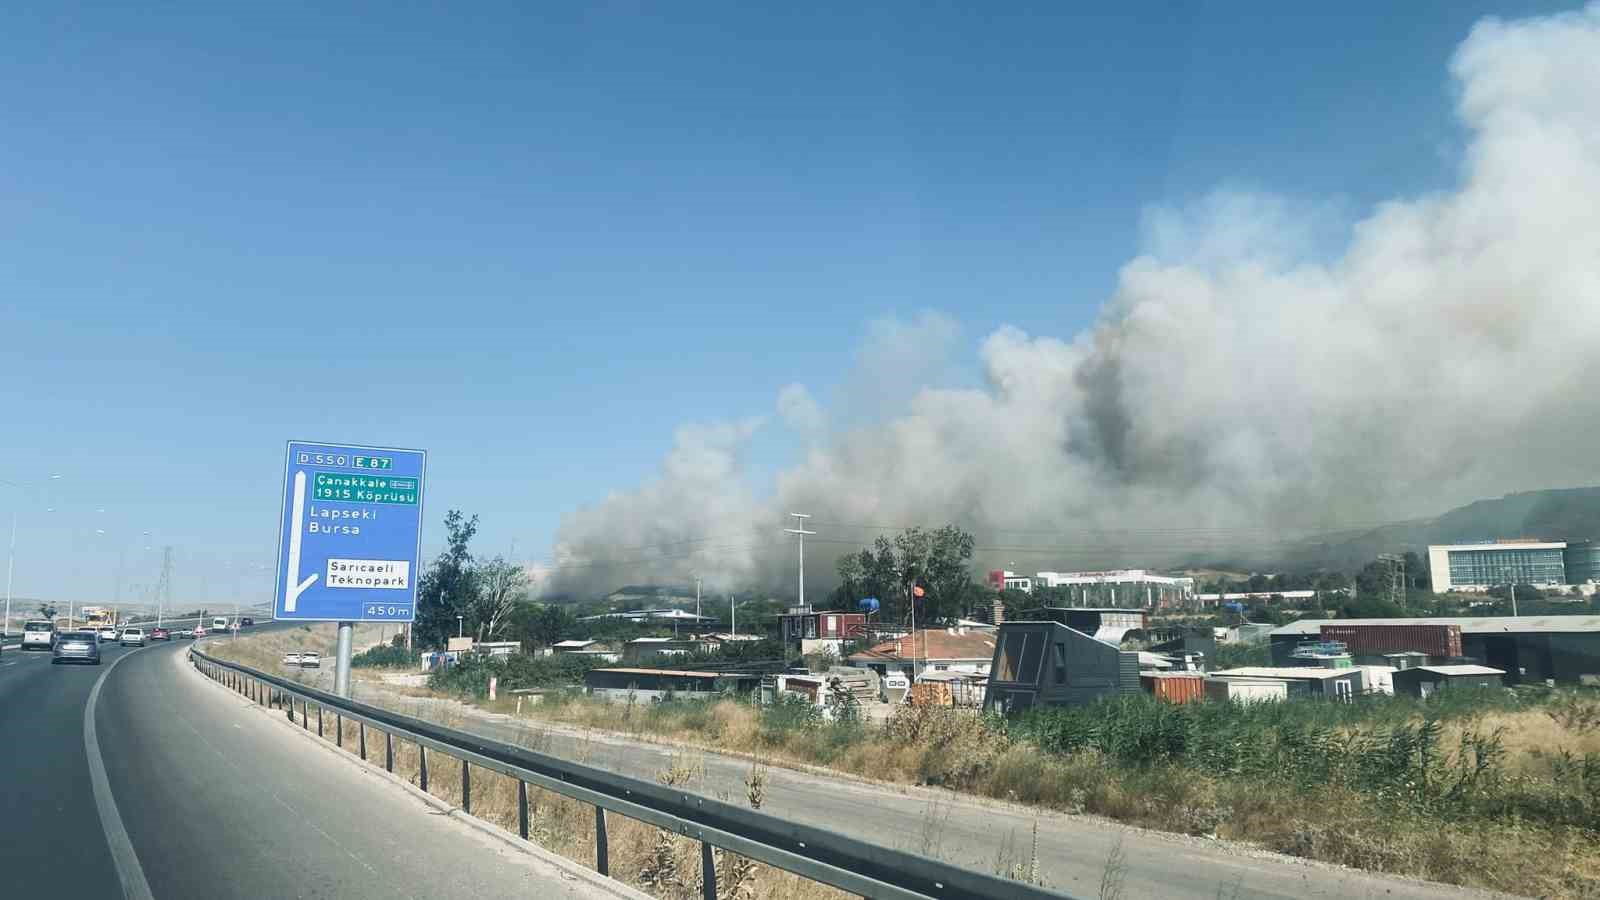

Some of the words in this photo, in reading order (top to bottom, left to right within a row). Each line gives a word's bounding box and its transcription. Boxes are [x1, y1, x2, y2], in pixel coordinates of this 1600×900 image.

[317, 475, 386, 488] Çanakkale
[316, 488, 351, 499] 1915
[356, 490, 414, 502] Köprüsü
[310, 506, 377, 520] Lapseki
[309, 522, 360, 535] Bursa
[330, 574, 405, 587] Teknopark
